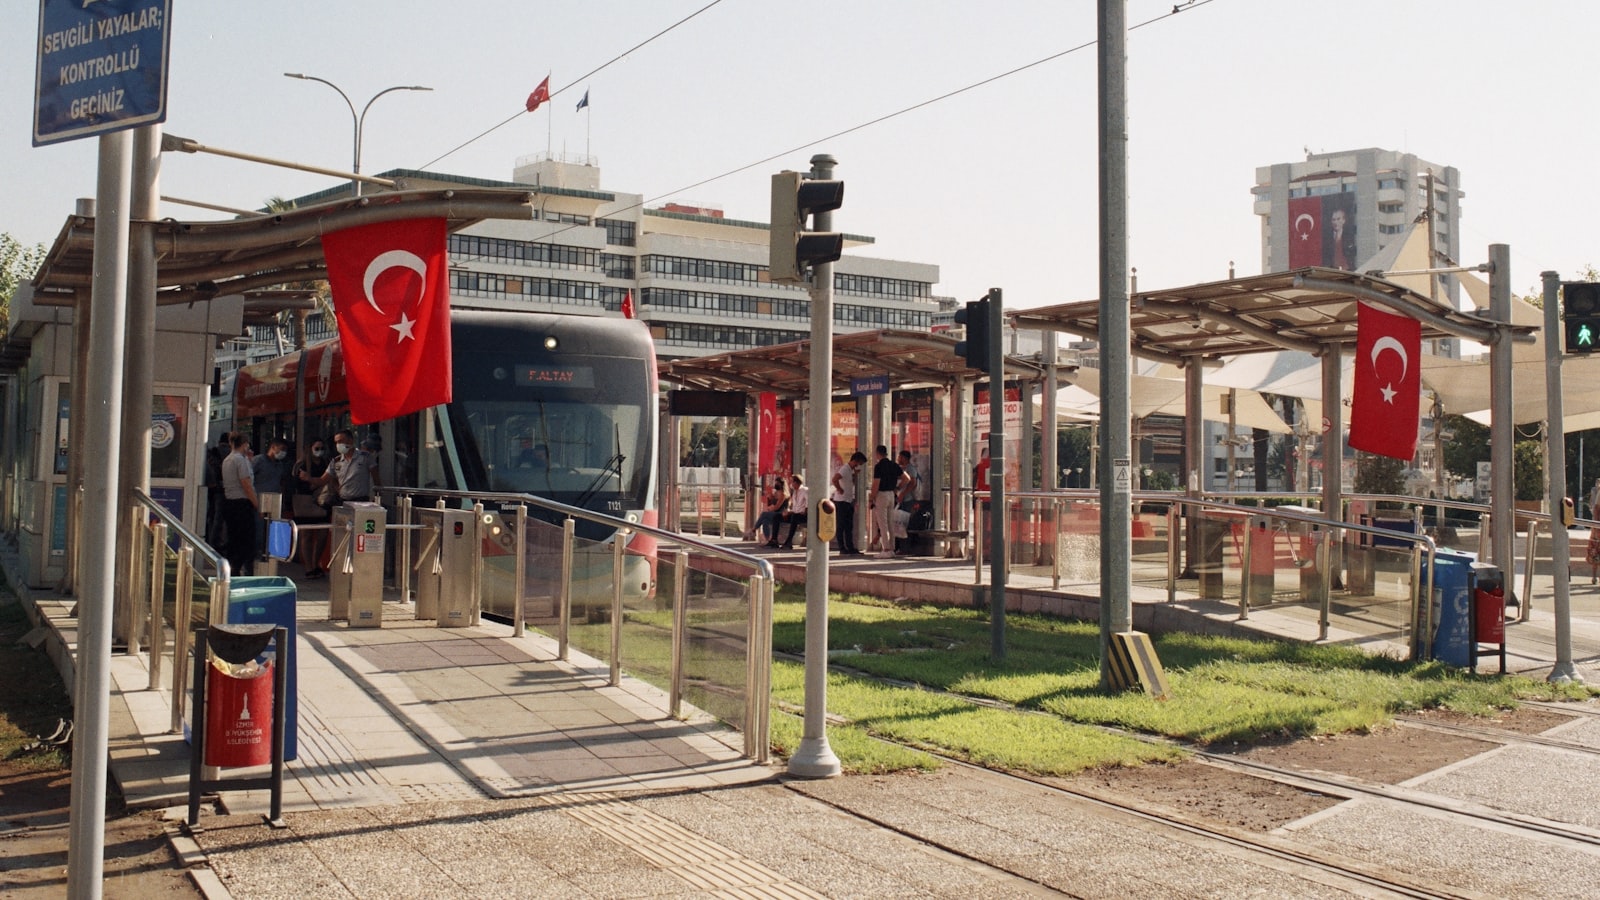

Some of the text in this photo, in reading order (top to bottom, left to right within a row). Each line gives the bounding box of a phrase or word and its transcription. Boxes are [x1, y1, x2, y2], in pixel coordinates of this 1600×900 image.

[44, 6, 162, 54] SEVGİLİ YAYALAR;
[60, 44, 140, 86] KONTROLLÜ
[607, 500, 622, 511] T121
